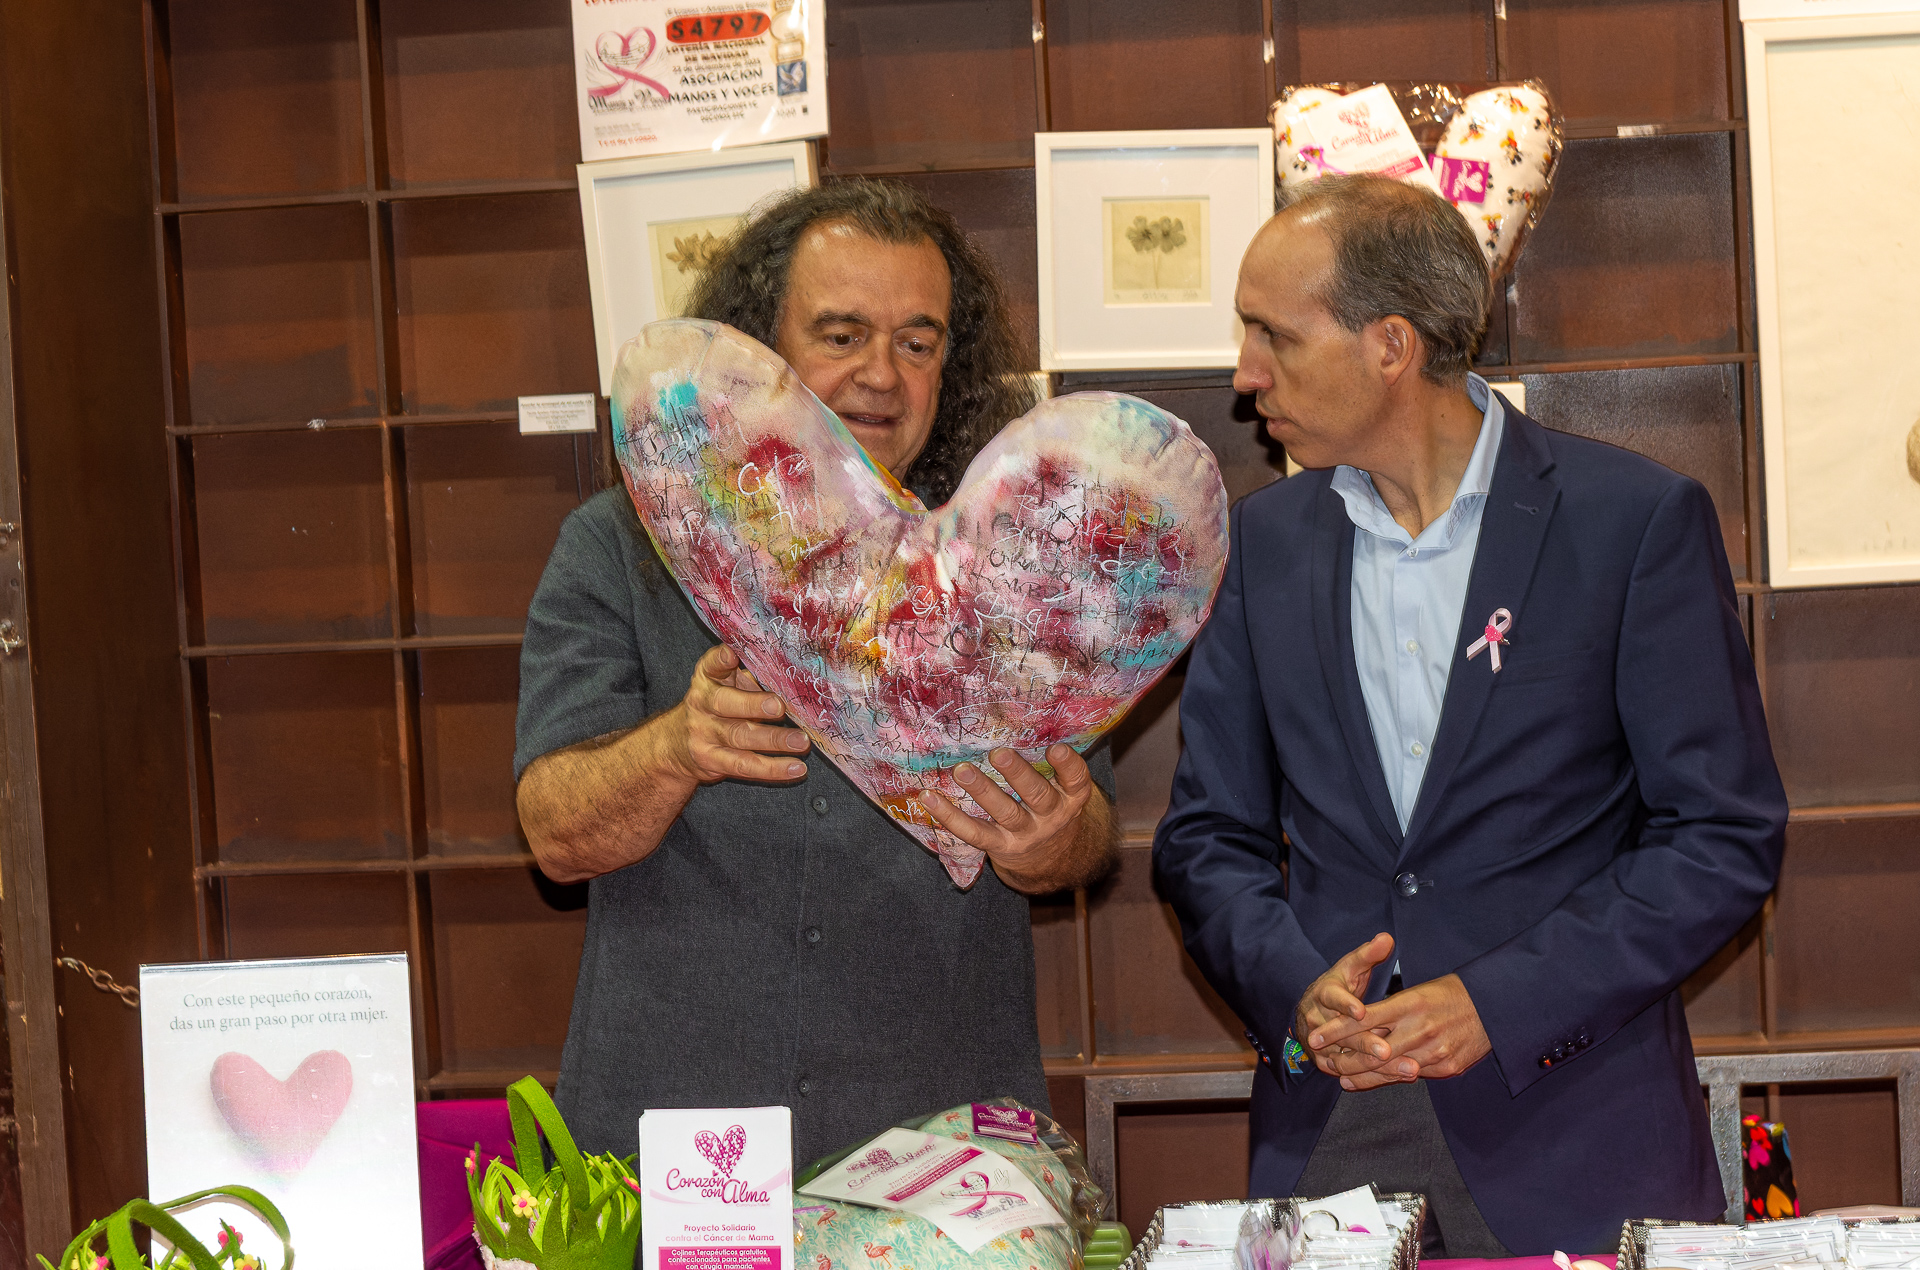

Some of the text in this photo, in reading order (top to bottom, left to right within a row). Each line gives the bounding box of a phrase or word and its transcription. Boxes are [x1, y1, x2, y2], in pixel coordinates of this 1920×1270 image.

[671, 13, 764, 40] 54797
[713, 37, 765, 49] NACIONAL
[684, 49, 749, 62] DE NAVIDAD
[680, 68, 763, 85] ASOCIACION
[668, 89, 717, 105] MANOS
[720, 87, 729, 100] Y
[732, 82, 775, 98] VOCES
[183, 988, 372, 1009] Con este pequeño corazón,
[169, 1007, 388, 1032] das un gran paso por otra mujer.
[666, 1168, 725, 1191] Corazón
[701, 1178, 770, 1204] con Alma
[684, 1223, 756, 1233] Proyecto Solidario
[665, 1233, 774, 1242] contra el Cáncer de Mama
[671, 1247, 767, 1258] Cojines Terapéuticos gratuitos
[700, 1262, 722, 1270] cirugía
[723, 1262, 755, 1270] mamaria.
[721, 1257, 738, 1265] para
[739, 1256, 771, 1264] pacientes
